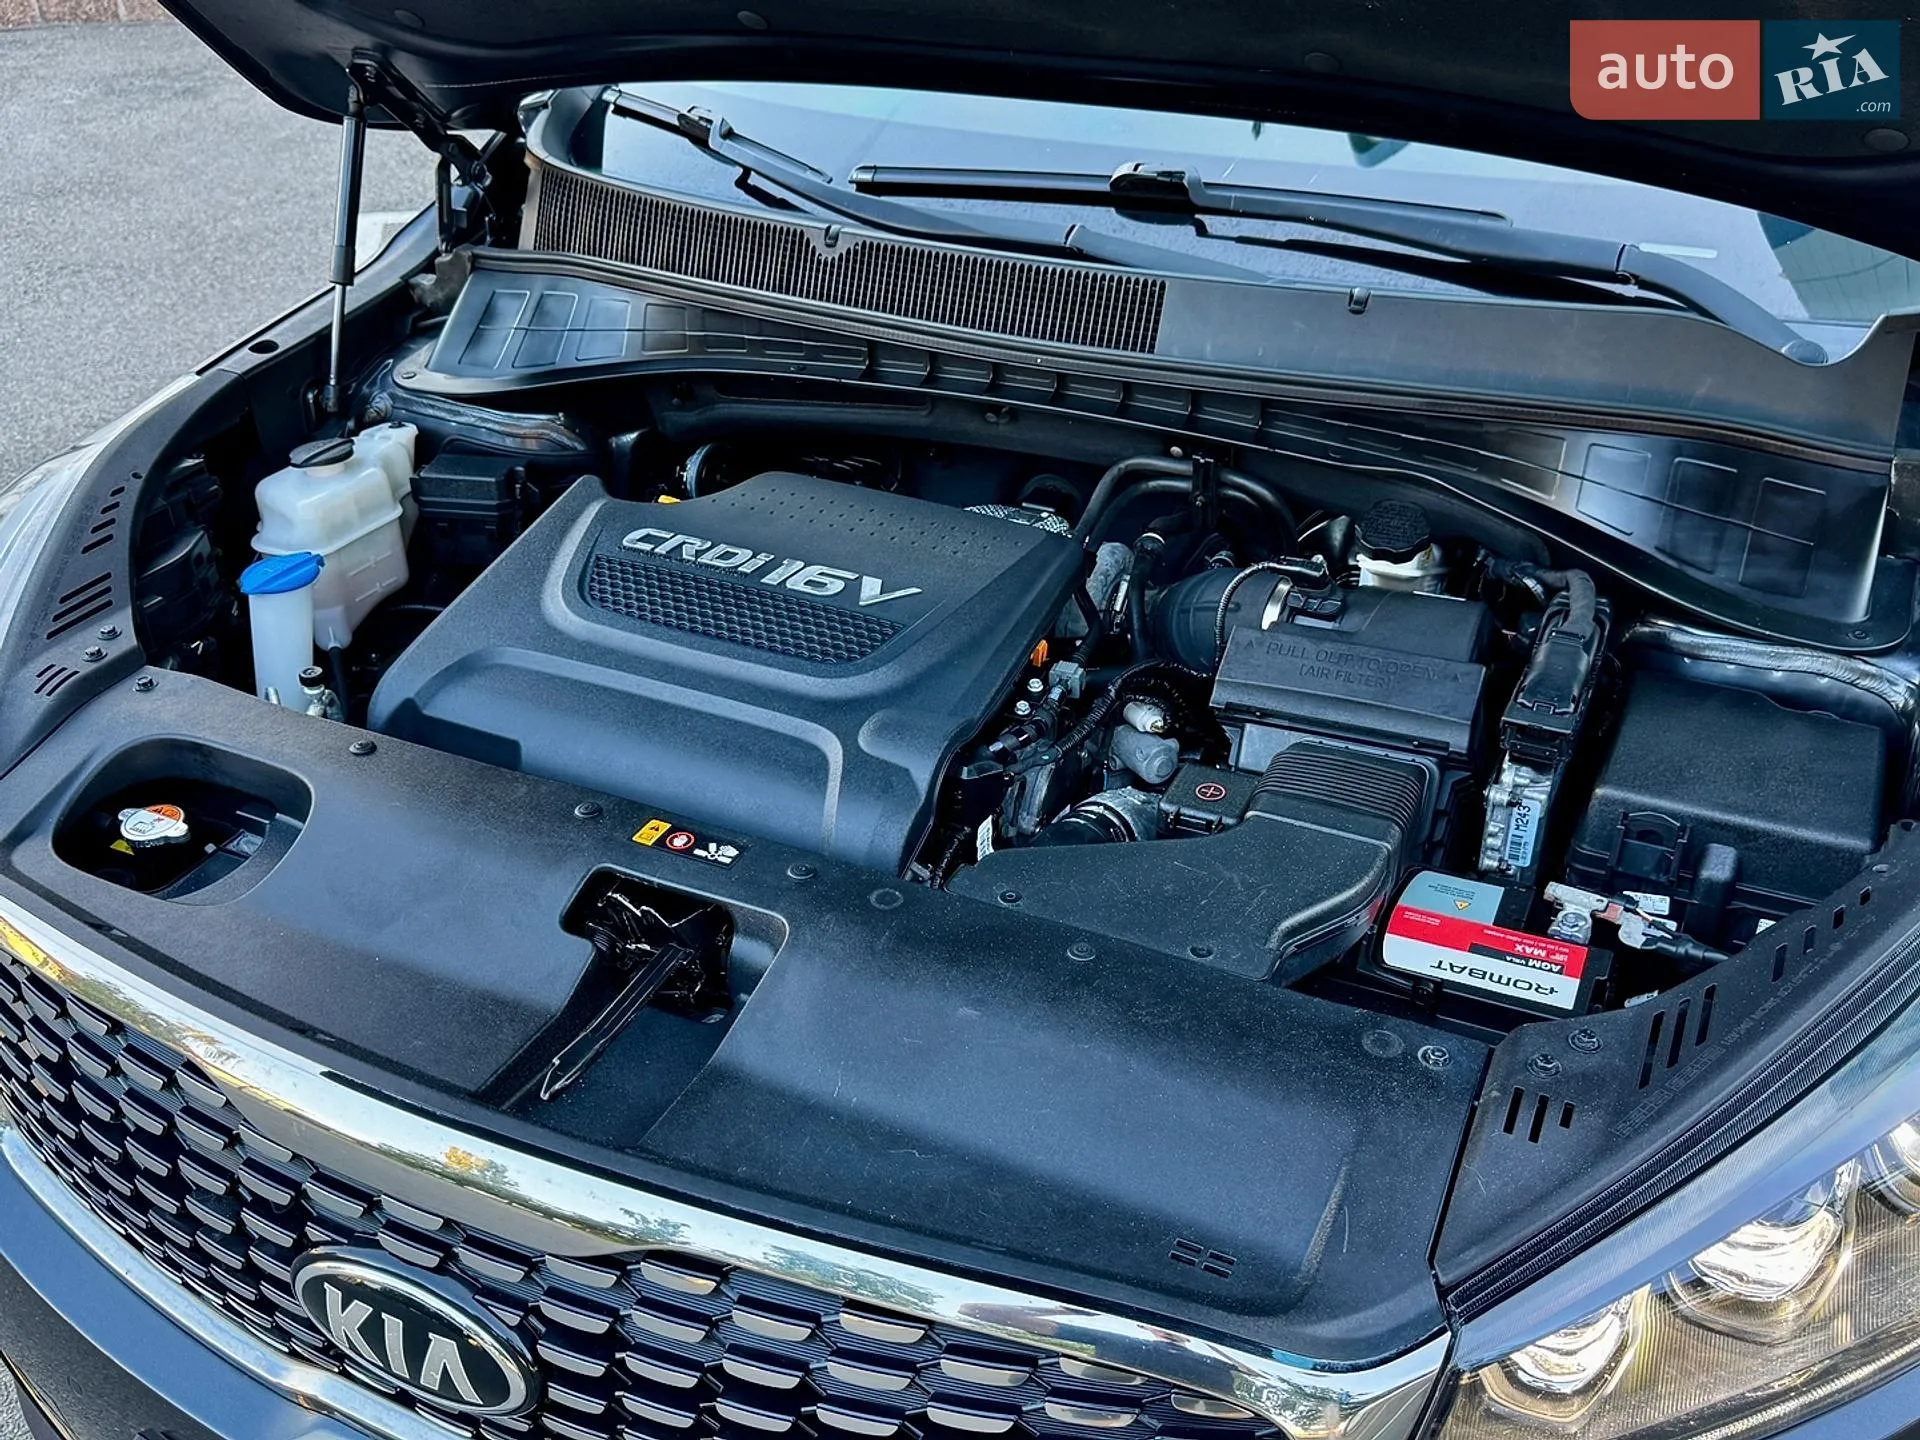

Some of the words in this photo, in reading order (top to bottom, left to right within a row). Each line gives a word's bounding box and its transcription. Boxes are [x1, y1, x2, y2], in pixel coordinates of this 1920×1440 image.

[621, 527, 775, 574] CRDi
[760, 557, 923, 606] 16V
[1266, 641, 1309, 660] PULL
[1315, 648, 1355, 666] OUT
[1514, 943, 1547, 958] MAX
[1519, 958, 1562, 973] AGM
[1430, 958, 1560, 996] ROMBAT
[324, 1281, 484, 1405] KIA
